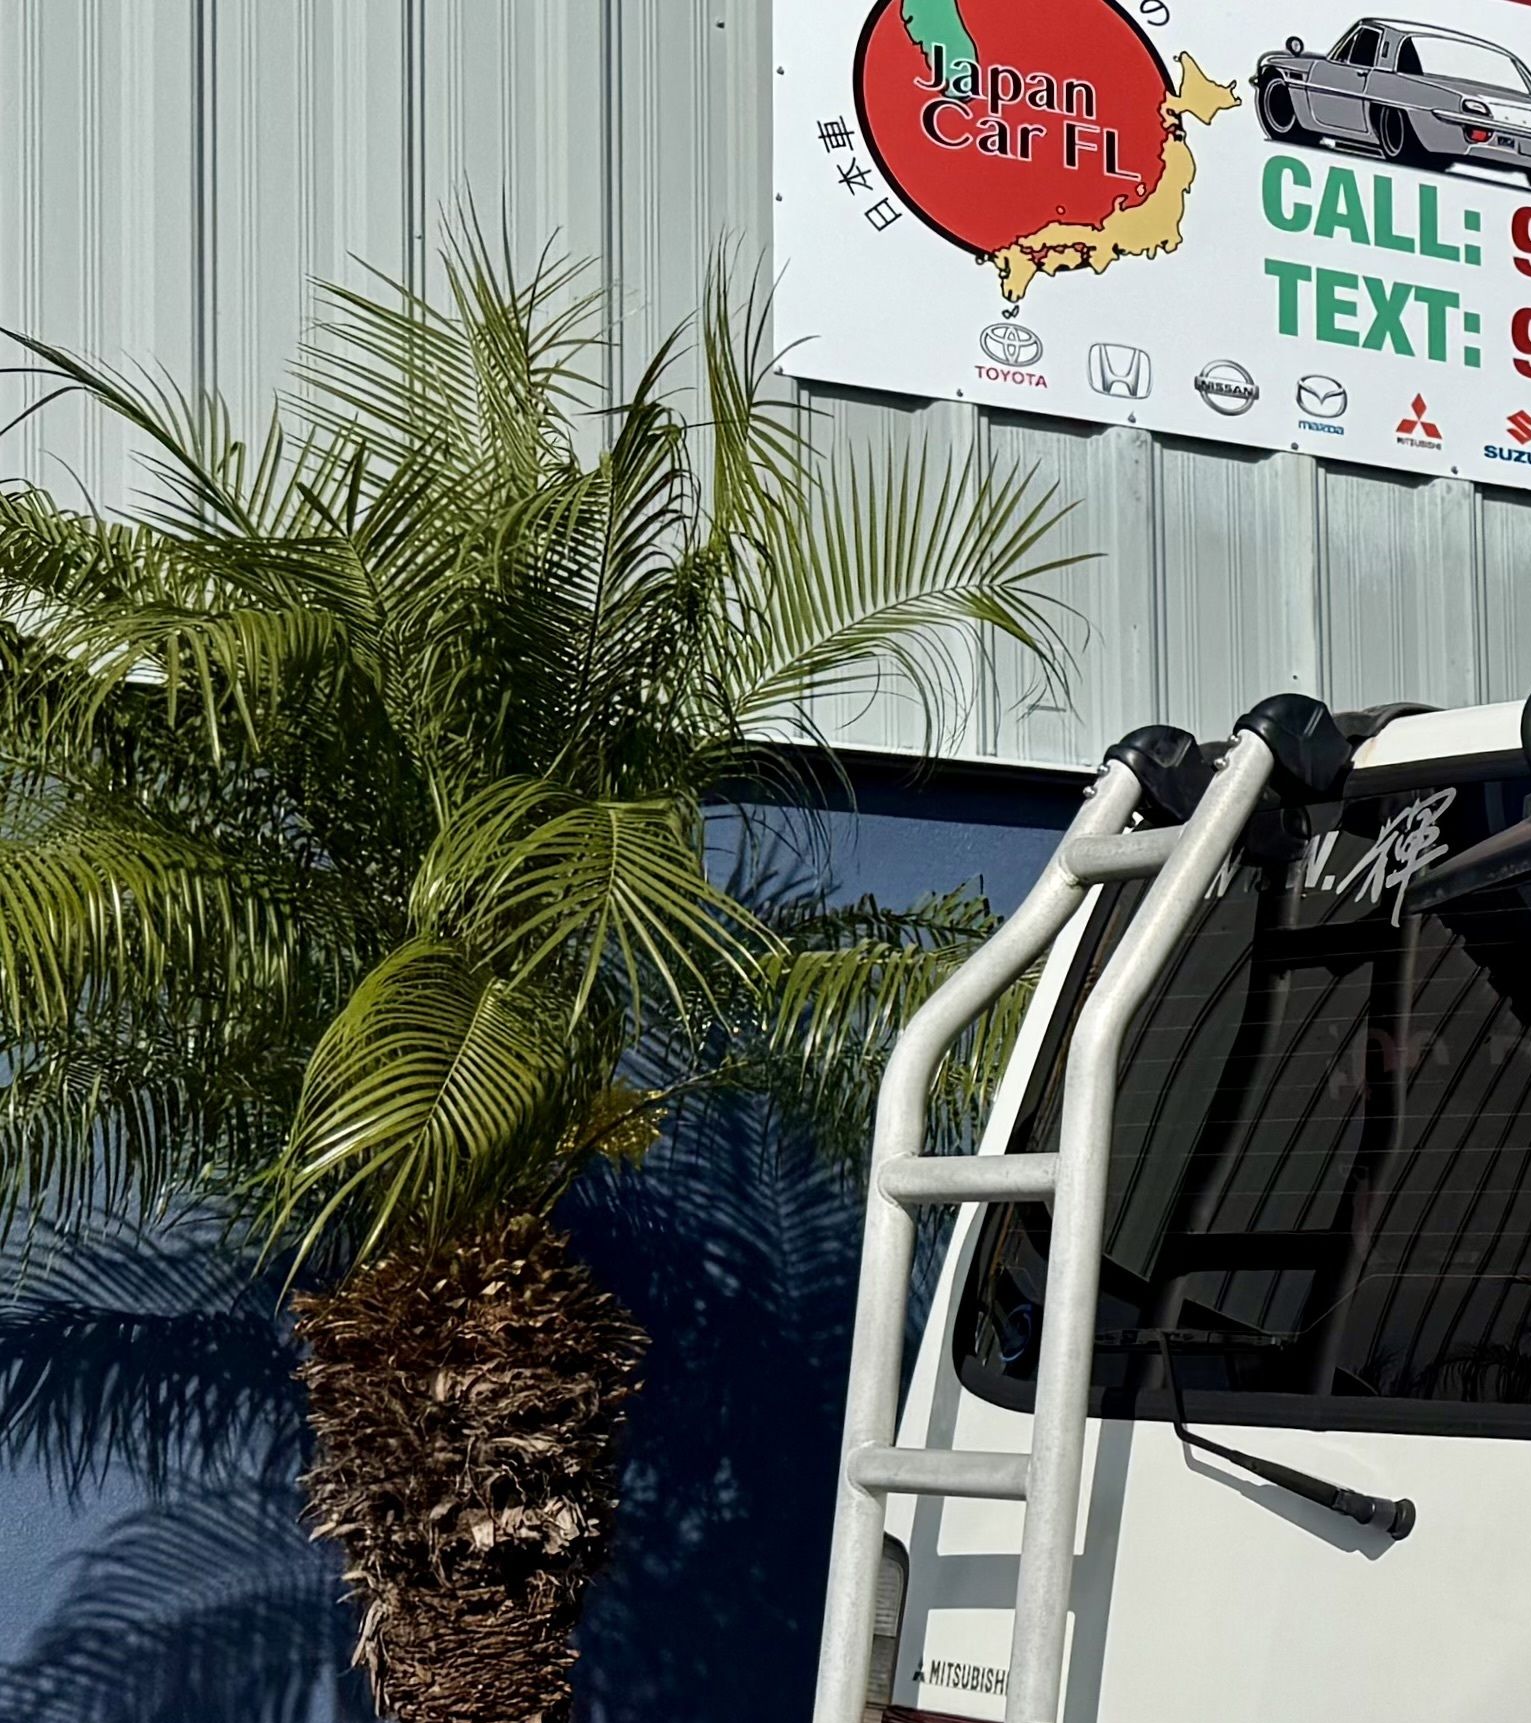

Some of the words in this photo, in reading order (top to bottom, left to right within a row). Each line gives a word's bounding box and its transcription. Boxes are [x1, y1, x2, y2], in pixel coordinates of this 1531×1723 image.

[914, 42, 1096, 119] Japan
[920, 98, 1045, 160] Car
[1063, 120, 1141, 182] FL
[1261, 154, 1481, 266] CALL:
[1263, 258, 1481, 367] TEXT:
[975, 365, 1048, 389] TOYOTA
[1201, 380, 1253, 397] NISSAN
